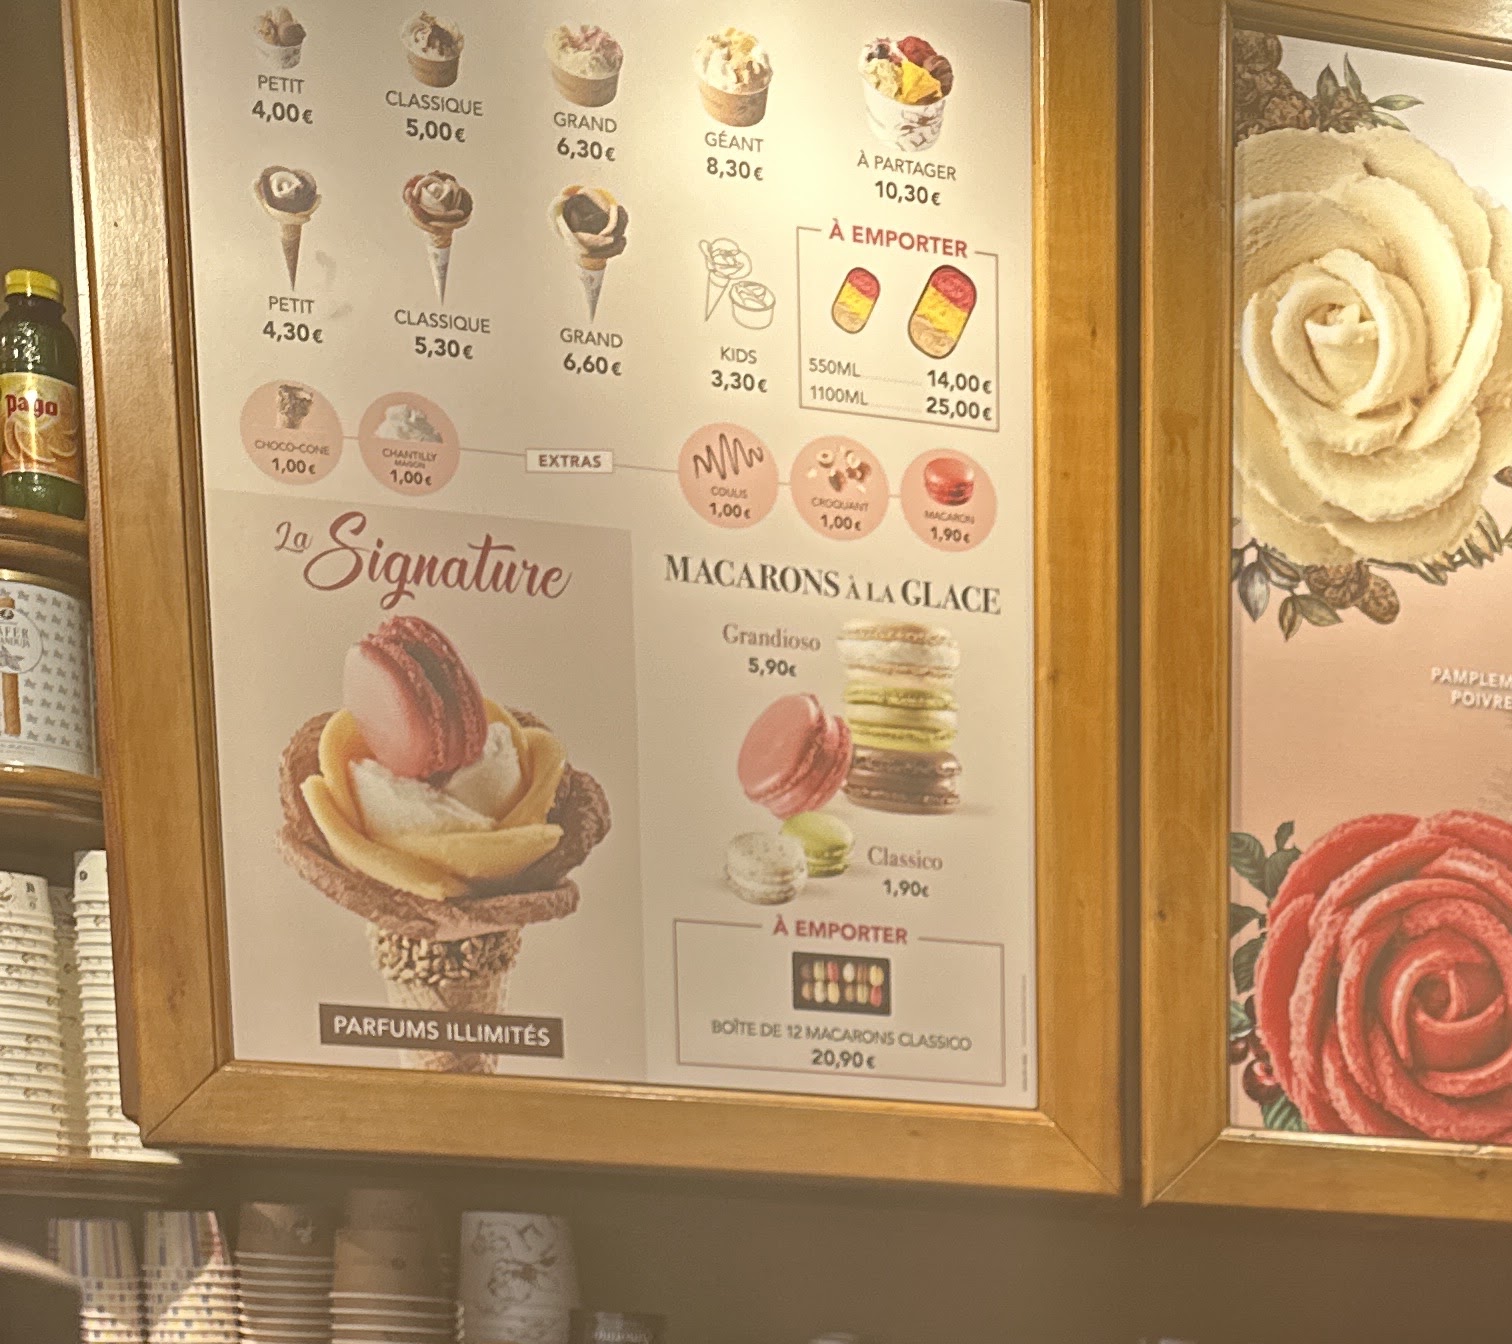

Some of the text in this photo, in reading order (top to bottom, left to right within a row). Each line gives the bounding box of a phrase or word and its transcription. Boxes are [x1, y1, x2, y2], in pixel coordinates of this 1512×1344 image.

[257, 75, 305, 94] PETIT
[385, 90, 483, 117] CLASSIQUE
[553, 111, 618, 134] GRAND
[704, 131, 764, 153] GÉANT
[856, 150, 957, 181] À PARTAGER
[829, 218, 968, 259] À EMPORTER
[268, 296, 315, 315] PETIT
[394, 309, 491, 334] CLASSIQUE
[559, 328, 624, 349] GRAND
[720, 346, 757, 365] KIDS
[809, 357, 861, 378] 550ML
[810, 386, 868, 407] 1100ML
[382, 448, 437, 462] CHANTILLY
[538, 454, 602, 469] EXTRAS
[274, 511, 573, 610] La Signature
[664, 554, 1001, 616] MACARONS À LA GLACE
[722, 624, 821, 652] Grandioso
[747, 657, 797, 678] 5,90€
[868, 845, 943, 872] Classico
[882, 878, 929, 899] 1,90€
[773, 914, 908, 945] À EMPORTER
[333, 1015, 550, 1048] PARFUMS ILLIMITÉS
[711, 1018, 972, 1051] BOÎTE DE 12 MACARONS CLASSICO
